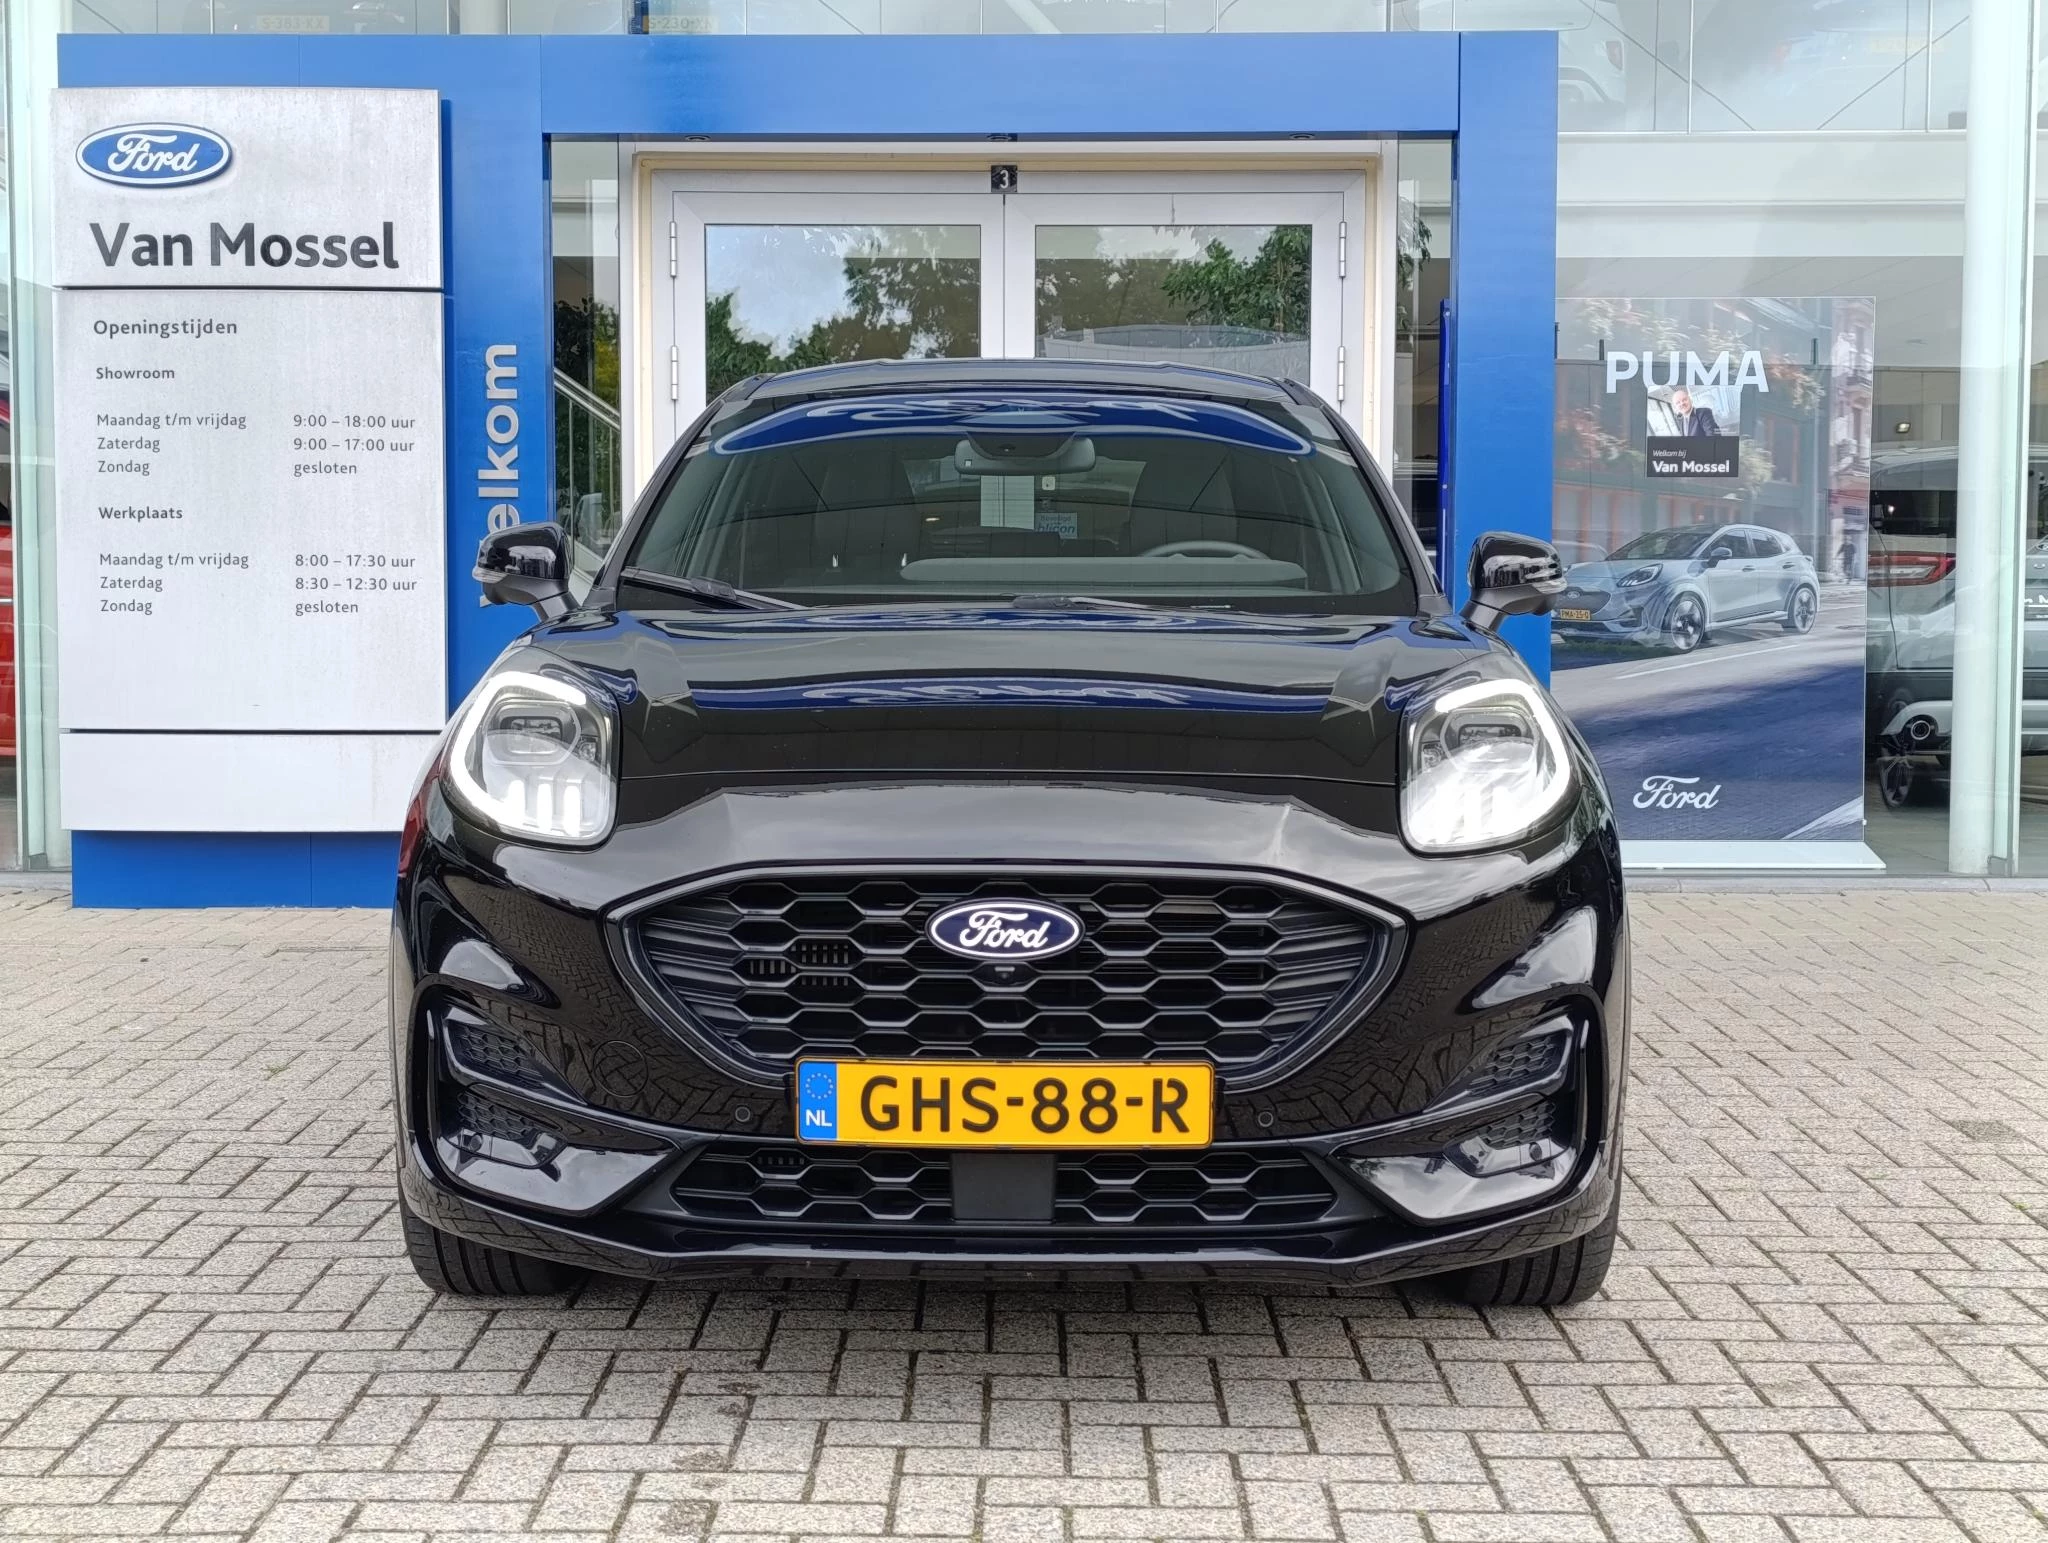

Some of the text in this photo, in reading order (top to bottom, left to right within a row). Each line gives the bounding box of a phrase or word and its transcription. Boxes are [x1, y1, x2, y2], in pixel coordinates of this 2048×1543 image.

[107, 133, 200, 173] Ford
[1000, 169, 1009, 189] 3
[89, 221, 400, 270] Van Mossel
[93, 318, 237, 340] Openingstijden
[96, 366, 175, 380] Showroom
[1605, 350, 1770, 394] PUMA
[97, 412, 161, 430] Maandag
[165, 412, 192, 426] t/m
[196, 412, 247, 430] vrijdag
[293, 414, 327, 428] 9:00
[344, 415, 386, 428] 18:00
[391, 419, 416, 429] uur
[97, 435, 161, 454] Zaterdag
[293, 437, 327, 451] 9:00
[344, 438, 385, 452] 17:00
[390, 442, 415, 452] uur
[1652, 449, 1687, 459] Welkom bij
[97, 459, 357, 478] Zondag gesloten
[477, 344, 520, 607] elkom
[1652, 459, 1730, 473] Van Mossel
[98, 505, 183, 523] Werkplaats
[99, 552, 164, 570] Maandag
[167, 552, 194, 566] t/m
[198, 552, 249, 570] vrijdag
[295, 554, 329, 567] 8:00
[346, 554, 386, 568] 17:30
[391, 558, 416, 568] uur
[100, 575, 163, 593] Zaterdag
[295, 577, 329, 590] 8:30
[346, 577, 388, 591] 12:30
[392, 581, 417, 591] uur
[100, 598, 359, 617] Zondag gesloten
[1632, 775, 1722, 809] Ford
[959, 910, 1051, 949] Ford
[805, 1075, 1190, 1134] NL GHS-88-R
